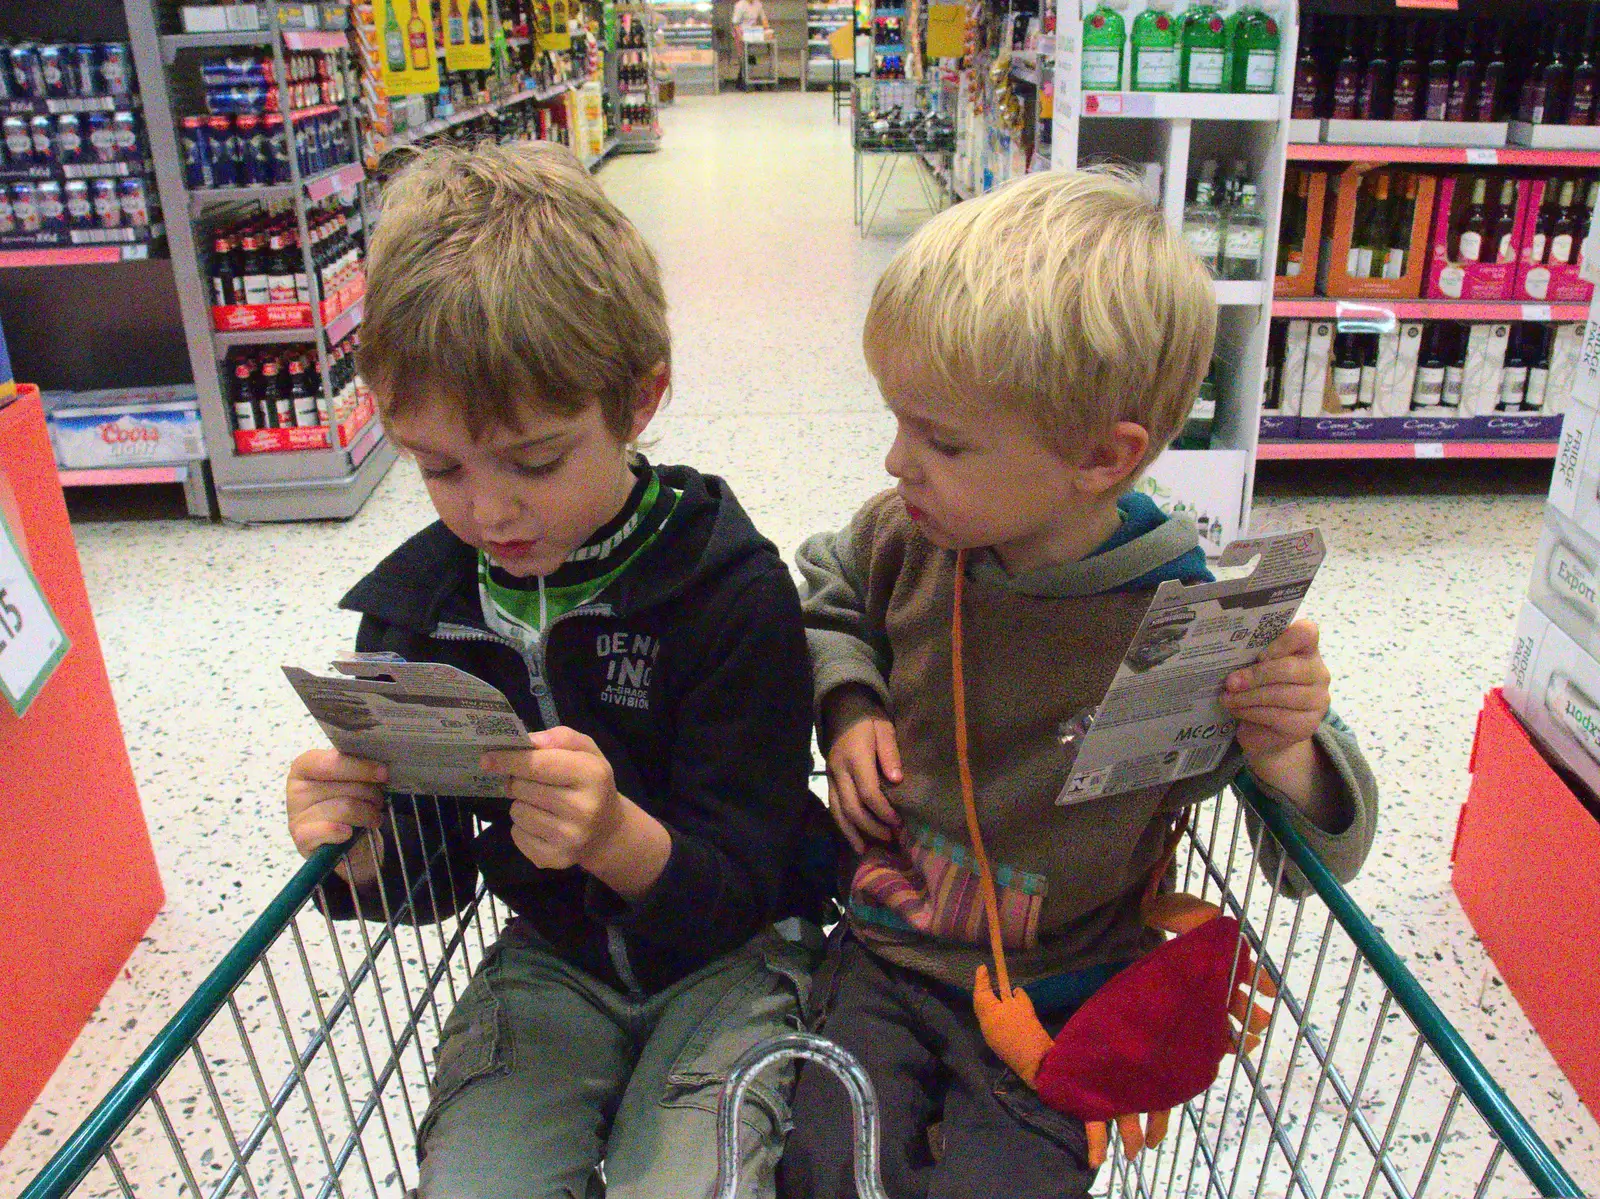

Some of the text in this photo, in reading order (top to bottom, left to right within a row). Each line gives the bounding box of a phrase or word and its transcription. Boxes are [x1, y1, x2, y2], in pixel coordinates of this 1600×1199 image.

[101, 422, 159, 445] Coors
[1558, 431, 1573, 474] PACK
[1565, 428, 1583, 490] FRIDGE
[1557, 560, 1596, 603] Export
[1510, 636, 1525, 674] PACK
[1516, 636, 1534, 689] FRIDGE
[600, 691, 650, 710] DIVISION
